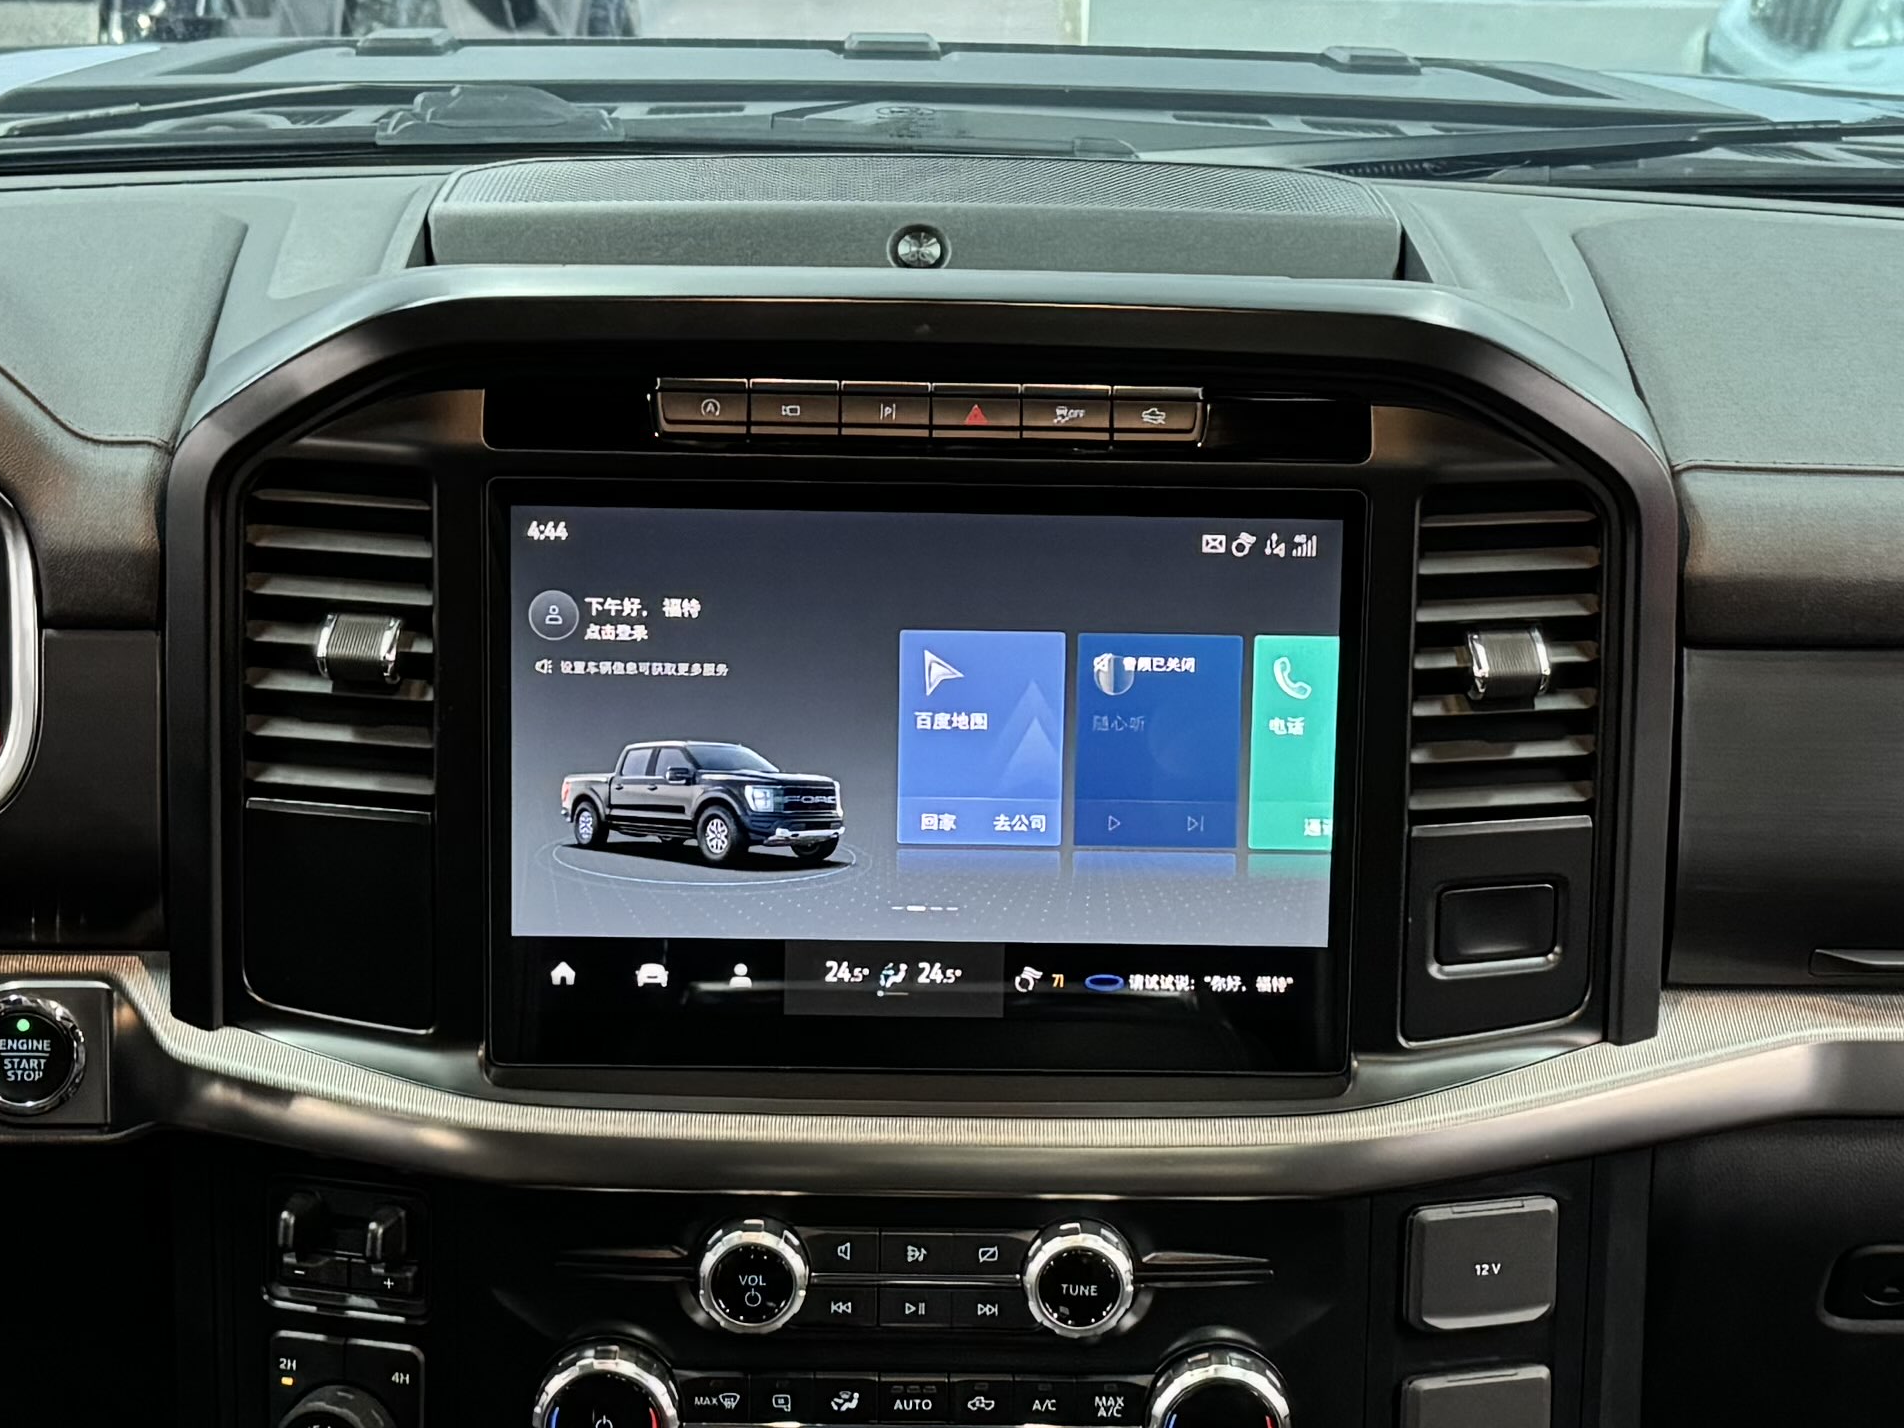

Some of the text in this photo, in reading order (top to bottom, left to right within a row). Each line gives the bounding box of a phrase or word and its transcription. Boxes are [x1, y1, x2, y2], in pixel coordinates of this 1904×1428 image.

[527, 521, 568, 541] 4:44
[584, 624, 649, 642] 点击登录
[1123, 657, 1196, 674] 音频已关闭
[914, 712, 988, 731] 百度地图
[1092, 715, 1145, 732] 随心听
[1268, 717, 1306, 736] 电话
[921, 813, 957, 831] 回家
[993, 815, 1046, 832] 去公司
[0, 1038, 52, 1051] ENGINE
[3, 1058, 47, 1070] START
[6, 1070, 43, 1082] STOP
[738, 1274, 767, 1287] VOL
[1060, 1284, 1099, 1297] TUNE
[279, 1357, 297, 1372] 2H
[391, 1371, 410, 1385] 4H
[694, 1396, 718, 1407] MAX
[894, 1399, 932, 1411] AUTO
[1032, 1399, 1057, 1412] A/C
[1095, 1396, 1124, 1408] MAX
[1097, 1406, 1122, 1418] A/C
